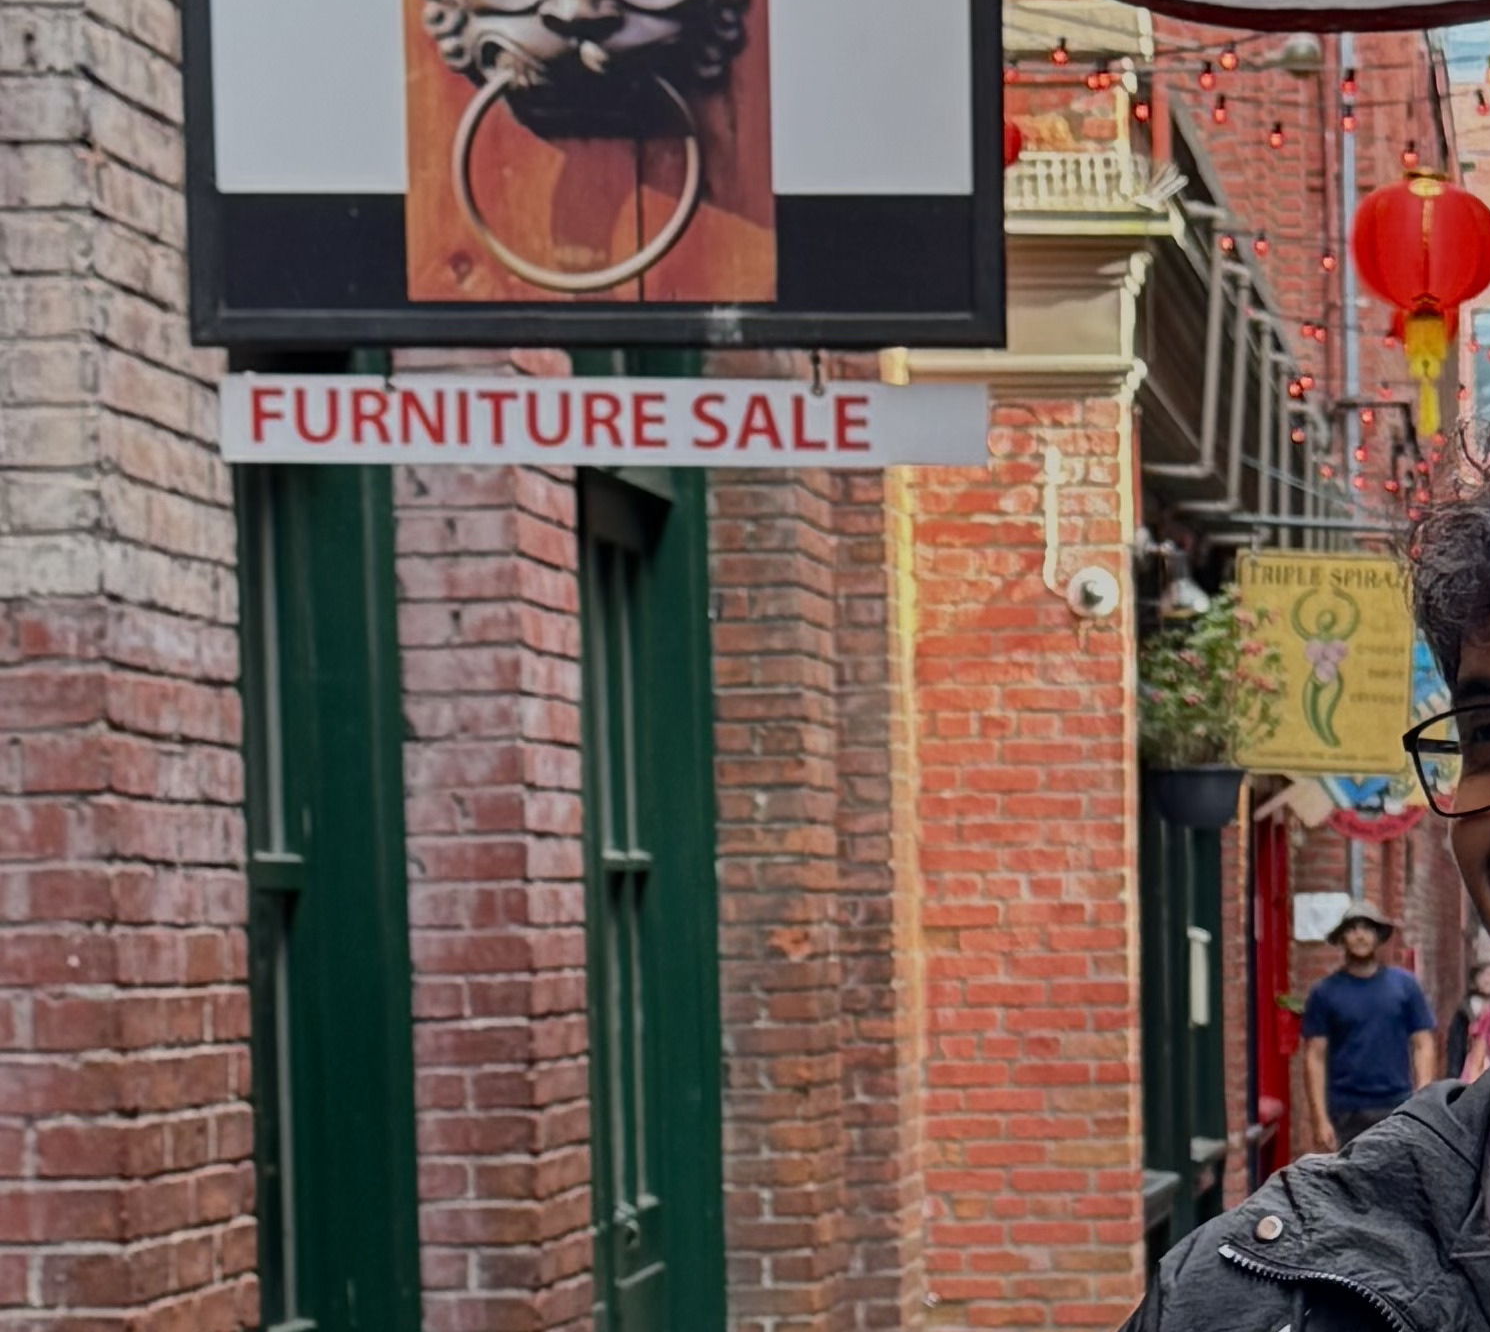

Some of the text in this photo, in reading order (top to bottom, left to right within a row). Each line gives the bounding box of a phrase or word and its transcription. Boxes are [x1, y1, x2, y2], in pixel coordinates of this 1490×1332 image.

[250, 386, 871, 452] FURNITURE SALE
[1249, 564, 1402, 589] TRIPLE SPIRA
